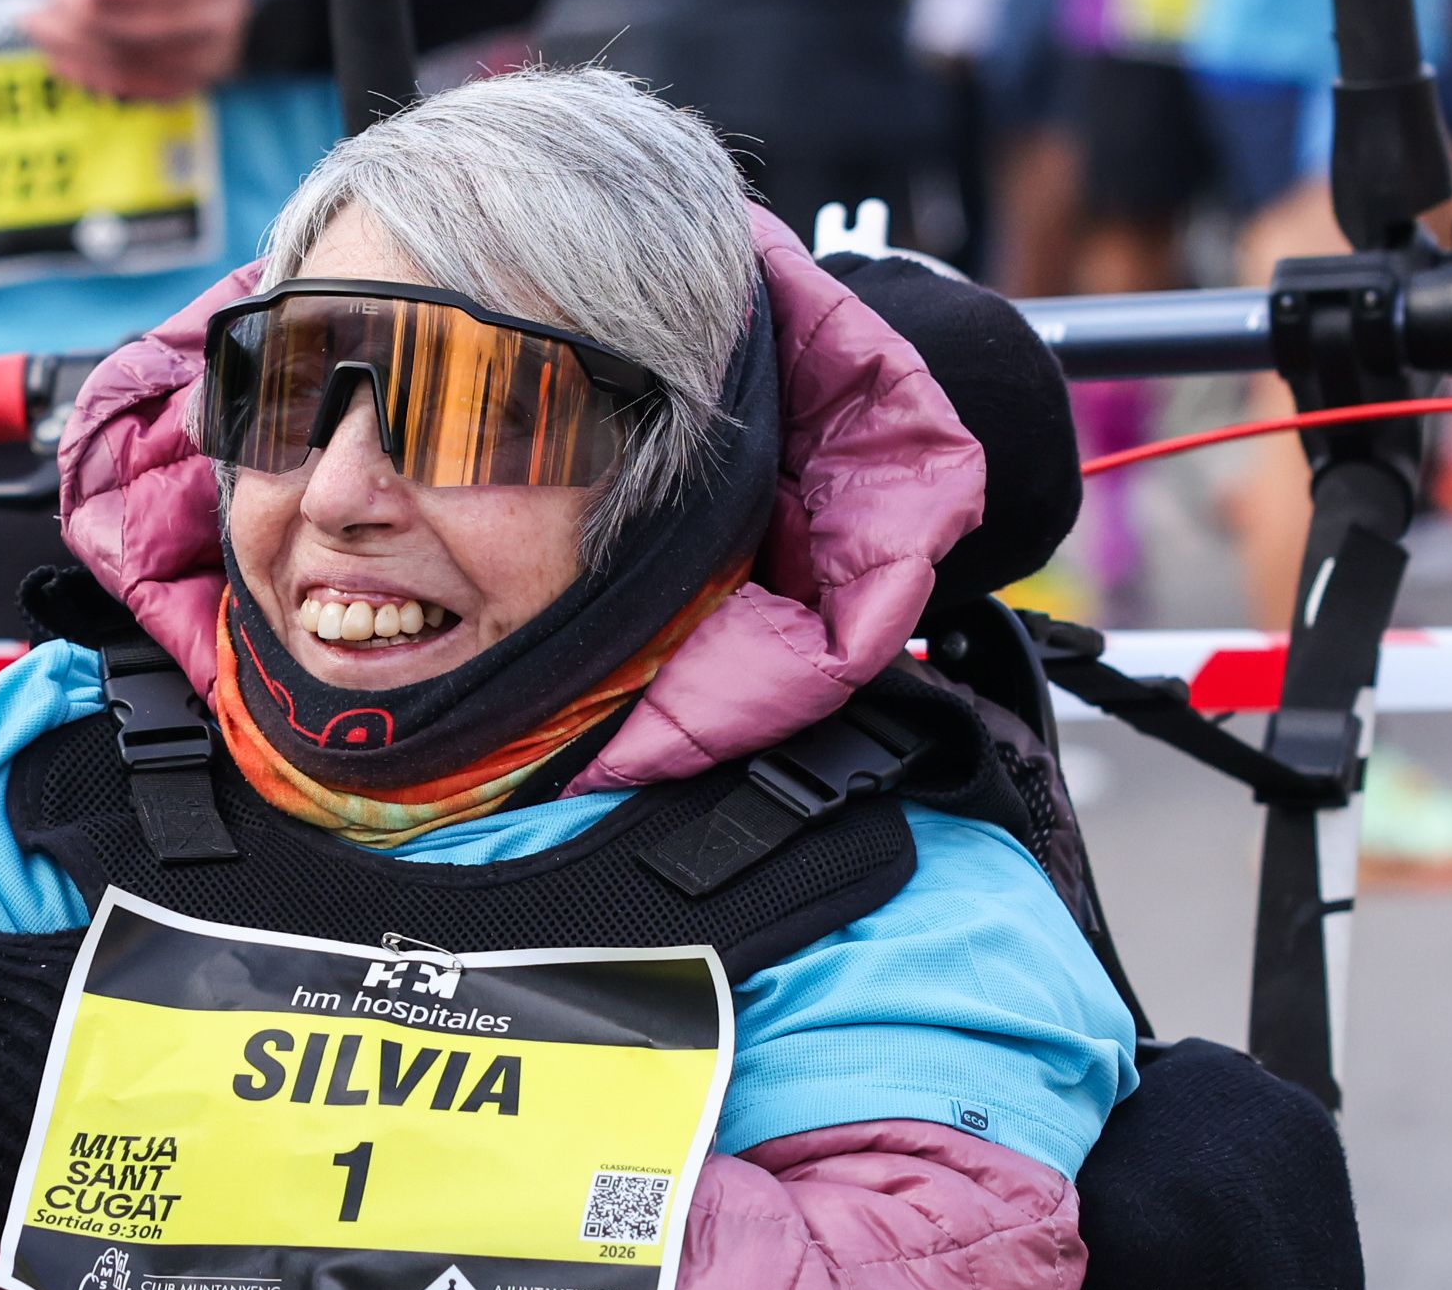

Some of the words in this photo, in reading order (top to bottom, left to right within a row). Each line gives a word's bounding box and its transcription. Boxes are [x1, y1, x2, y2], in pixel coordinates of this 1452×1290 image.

[291, 985, 342, 1011] hm
[351, 990, 513, 1034] hospitales
[232, 1028, 522, 1116] SILVIA
[964, 1114, 985, 1128] eco
[69, 1132, 178, 1163] MITJA
[66, 1160, 172, 1192] SANT
[332, 1141, 374, 1223] 1
[600, 1163, 673, 1175] CLASSIFICACIONS
[44, 1184, 182, 1222] CUGAT
[33, 1208, 104, 1234] Sortida
[107, 1222, 163, 1240] 9:30h
[599, 1244, 637, 1260] 2026
